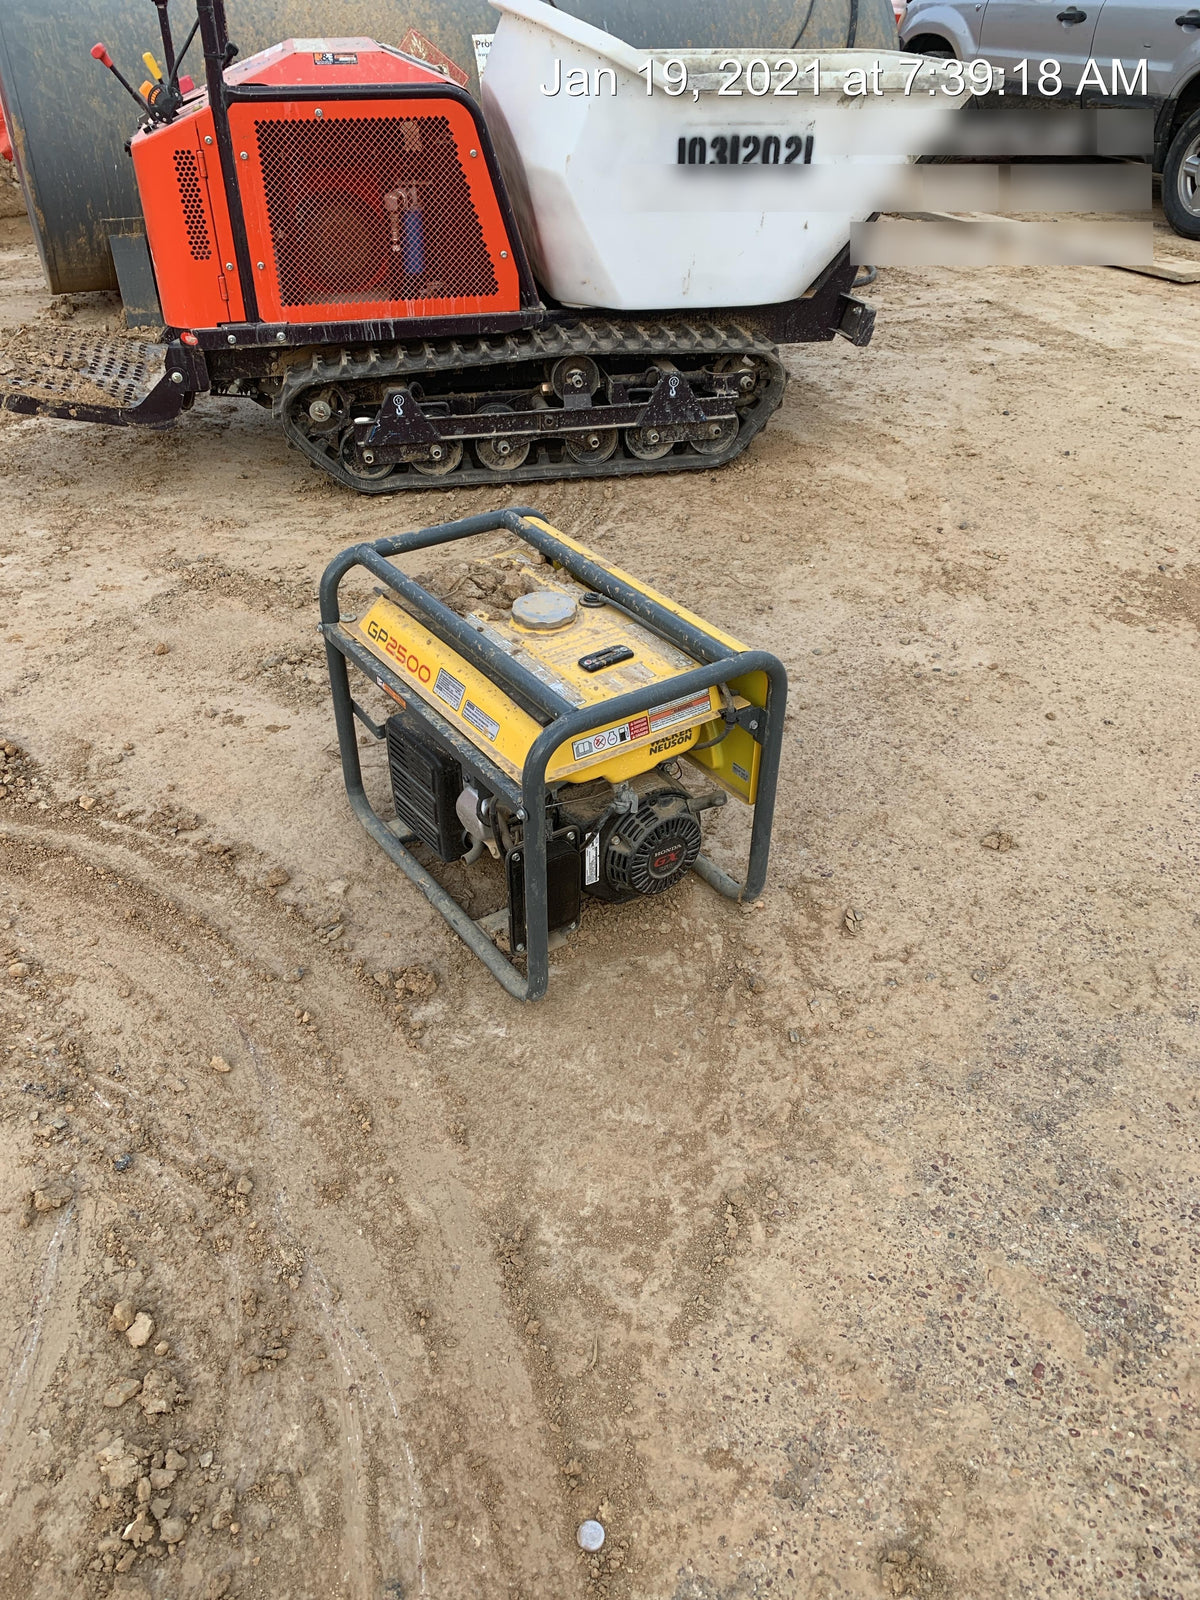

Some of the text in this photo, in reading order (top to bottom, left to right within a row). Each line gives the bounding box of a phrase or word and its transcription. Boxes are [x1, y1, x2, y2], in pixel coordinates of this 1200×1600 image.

[367, 620, 431, 683] GP2500
[649, 733, 692, 755] NEUSON
[654, 844, 682, 857] HONDA
[654, 850, 680, 867] GX
